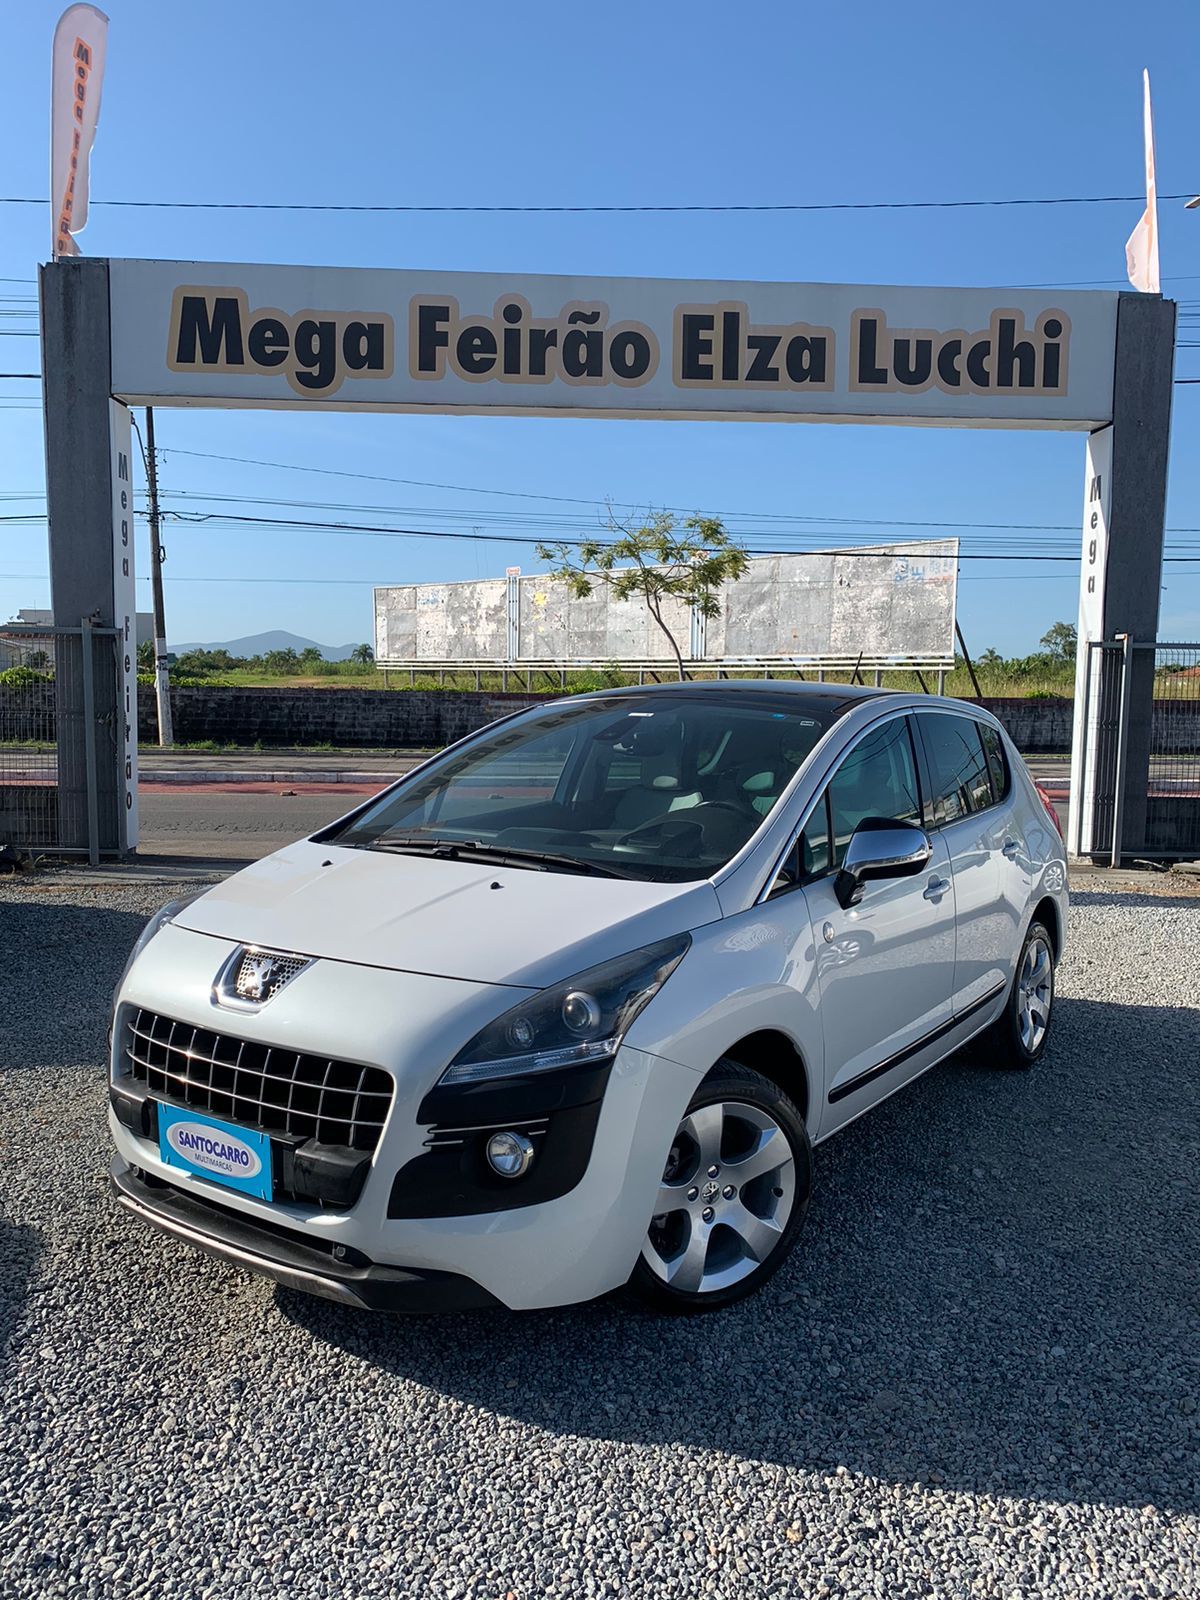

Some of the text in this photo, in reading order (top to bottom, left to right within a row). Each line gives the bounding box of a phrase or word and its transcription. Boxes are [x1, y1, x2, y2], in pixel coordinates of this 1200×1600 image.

[75, 41, 90, 120] Mega
[175, 296, 1061, 389] Mega Feirão Elza Lucchi
[118, 452, 129, 577] Mega
[1087, 475, 1102, 593] Mega
[178, 1130, 249, 1167] SANTOCARRO
[194, 1153, 233, 1173] MULTIMARCAS
